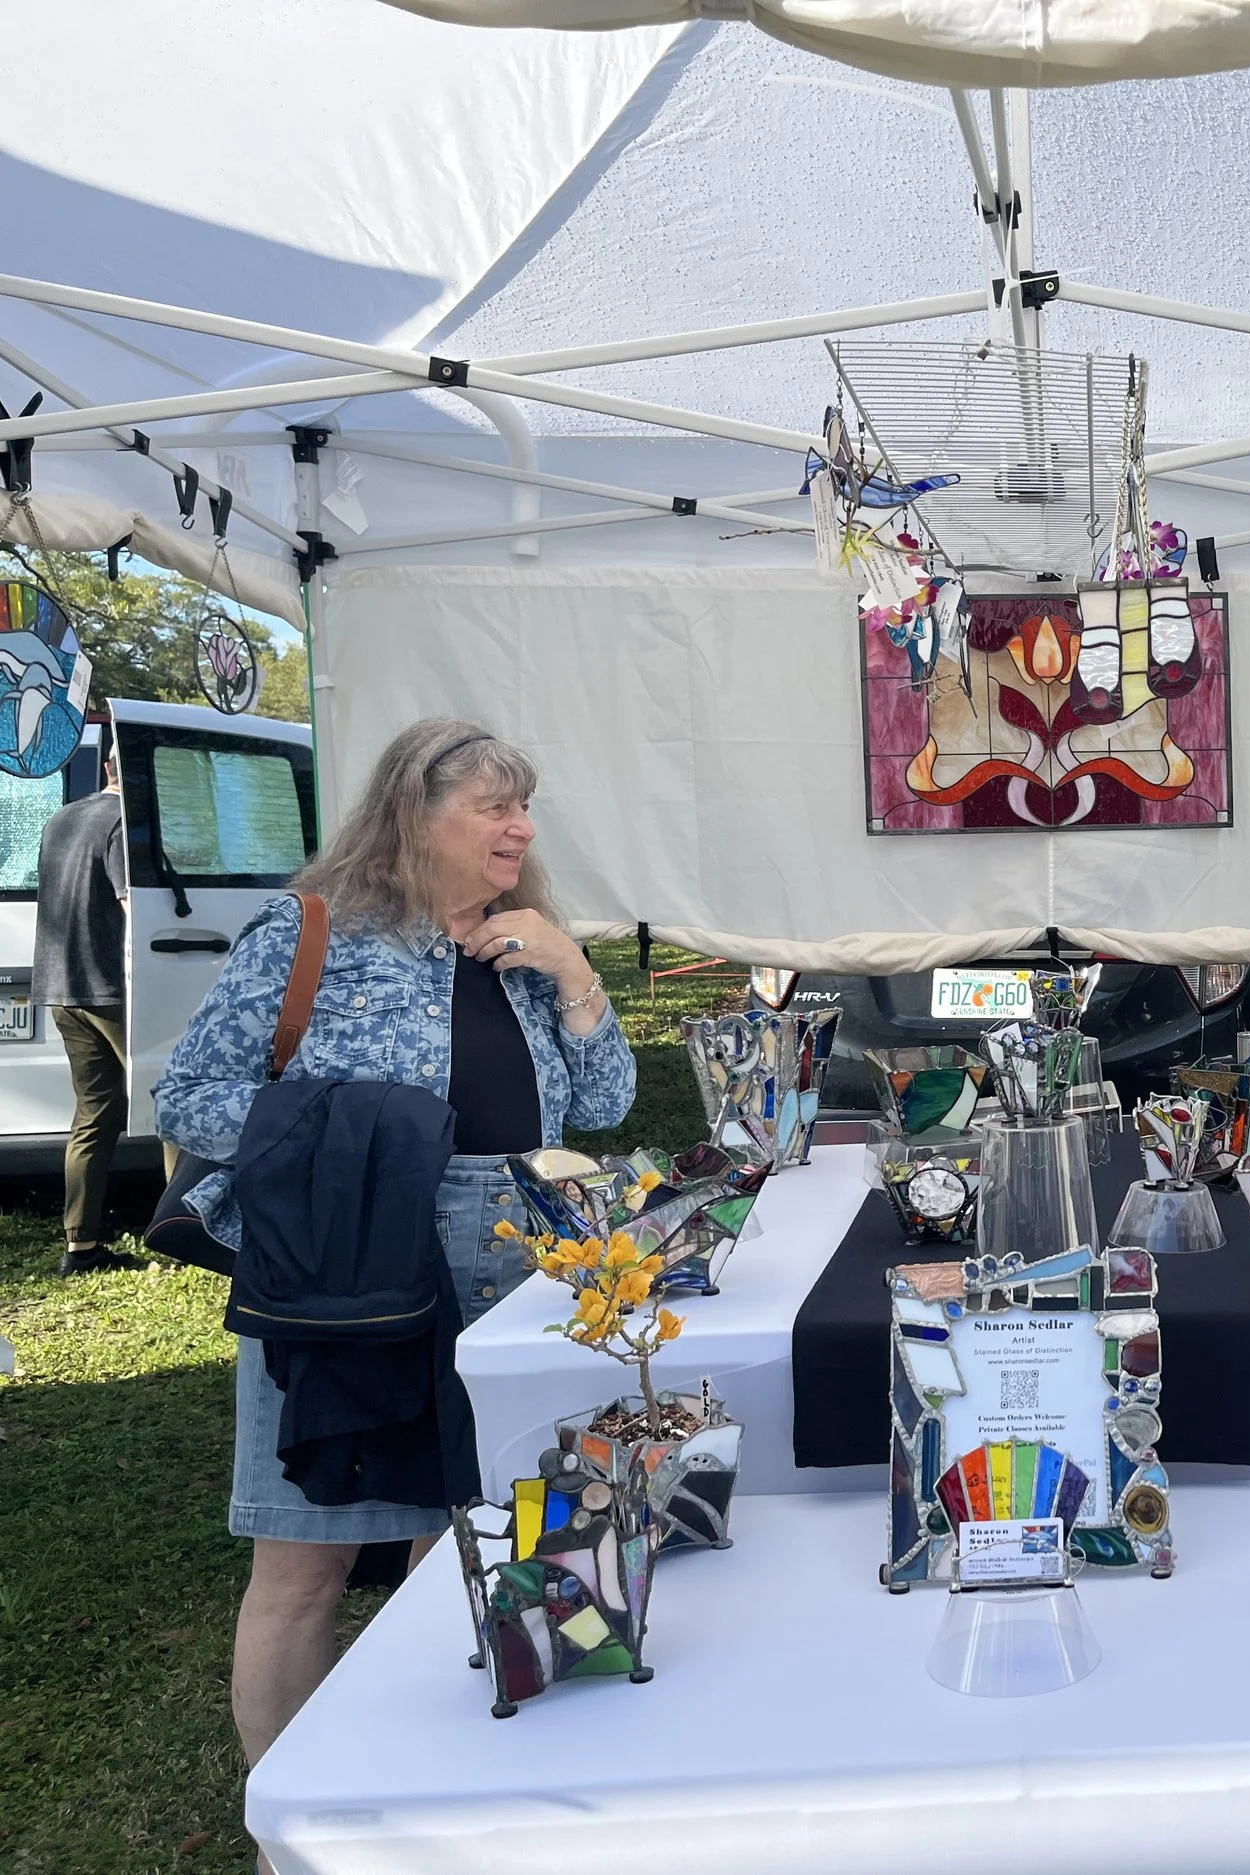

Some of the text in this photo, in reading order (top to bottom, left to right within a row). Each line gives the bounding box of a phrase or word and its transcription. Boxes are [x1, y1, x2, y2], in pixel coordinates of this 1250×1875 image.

[793, 991, 841, 1002] HR-V
[938, 982, 972, 1006] FDZ
[974, 1319, 1074, 1331] Sharon Sedlar
[1012, 1336, 1035, 1344] Artist
[702, 1379, 710, 1417] GOLD
